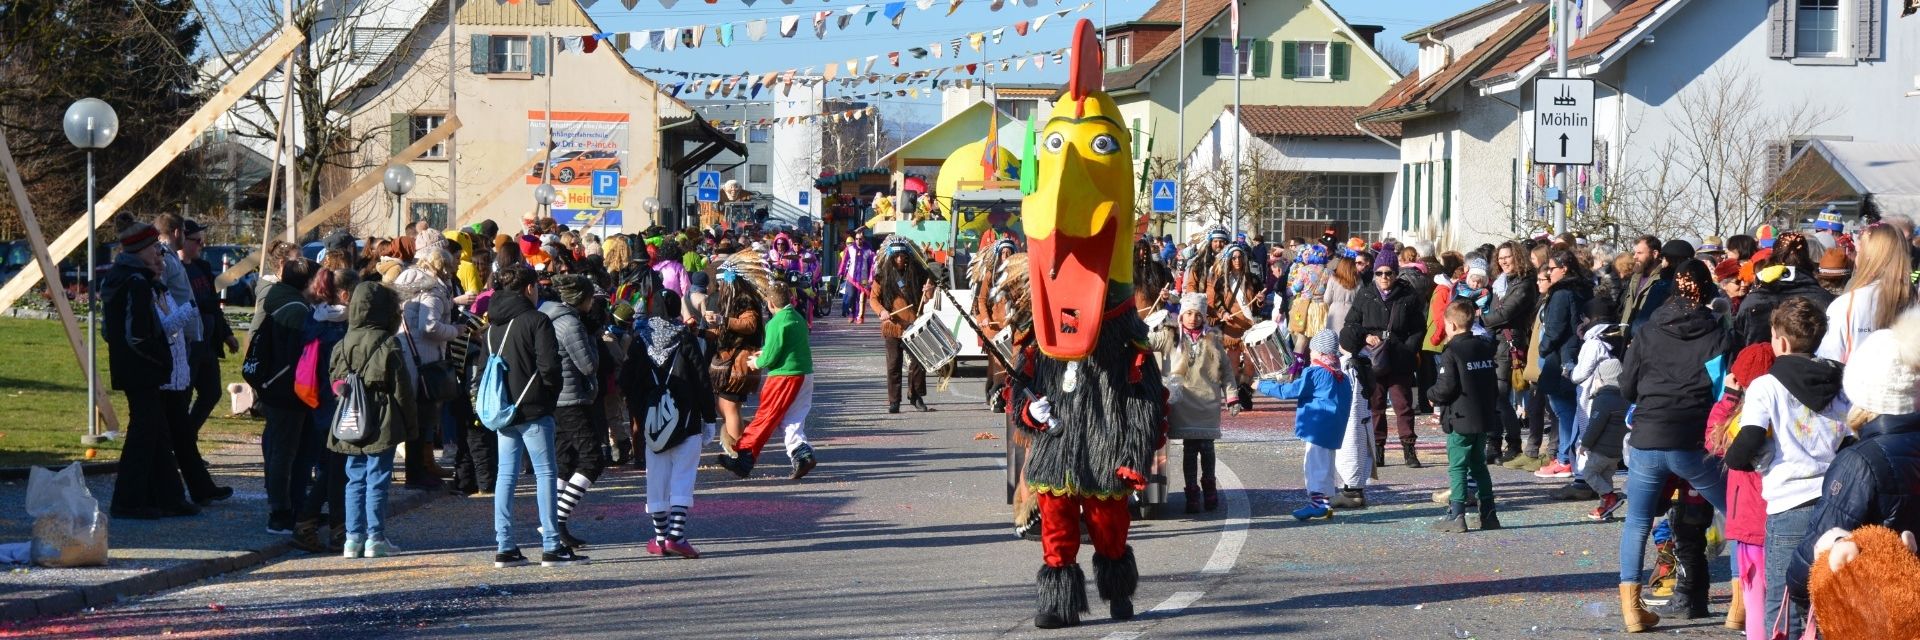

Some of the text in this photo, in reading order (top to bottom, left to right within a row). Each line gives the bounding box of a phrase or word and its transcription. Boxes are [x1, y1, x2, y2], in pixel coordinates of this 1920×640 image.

[1541, 112, 1588, 127] Möhlin
[550, 130, 609, 139] nhängerfahrschule
[600, 174, 613, 194] P
